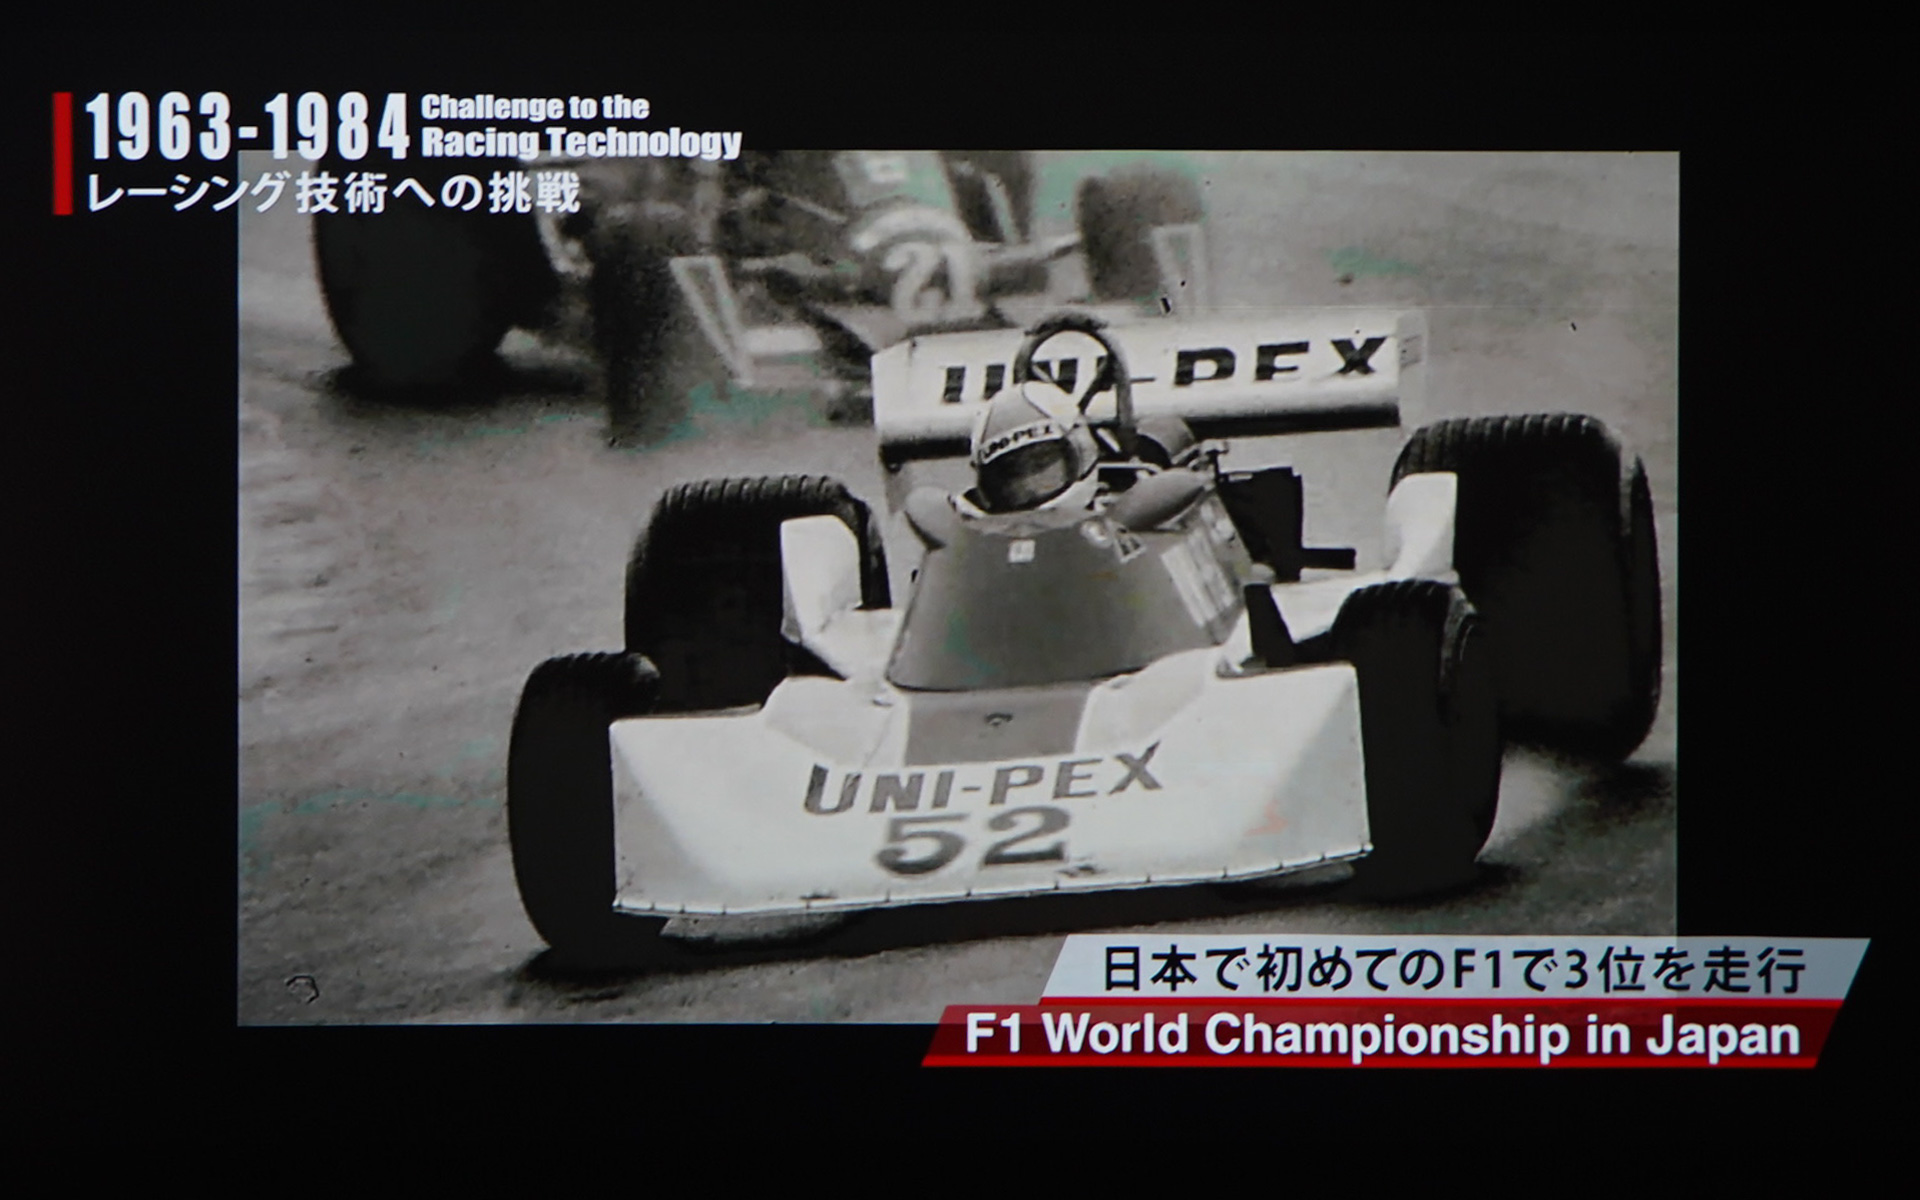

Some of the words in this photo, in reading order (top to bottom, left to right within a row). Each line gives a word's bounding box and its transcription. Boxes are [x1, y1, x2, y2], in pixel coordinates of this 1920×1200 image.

[84, 91, 410, 160] 1963-1984
[421, 94, 564, 122] Challenge
[569, 96, 597, 119] to
[602, 94, 650, 119] the
[421, 127, 540, 160] Racing
[545, 127, 743, 160] Technology
[88, 170, 581, 214] レーシング技術への挑戦
[803, 739, 1163, 815] UNI-PEX
[874, 805, 1072, 877] 52
[1104, 944, 1807, 993] 日本で初めてのF1で3位を走行
[966, 1012, 1022, 1053] F1
[1041, 1012, 1189, 1055] World
[1204, 1013, 1570, 1065] Championship
[1587, 1014, 1630, 1055] in
[1646, 1014, 1801, 1065] Japan
